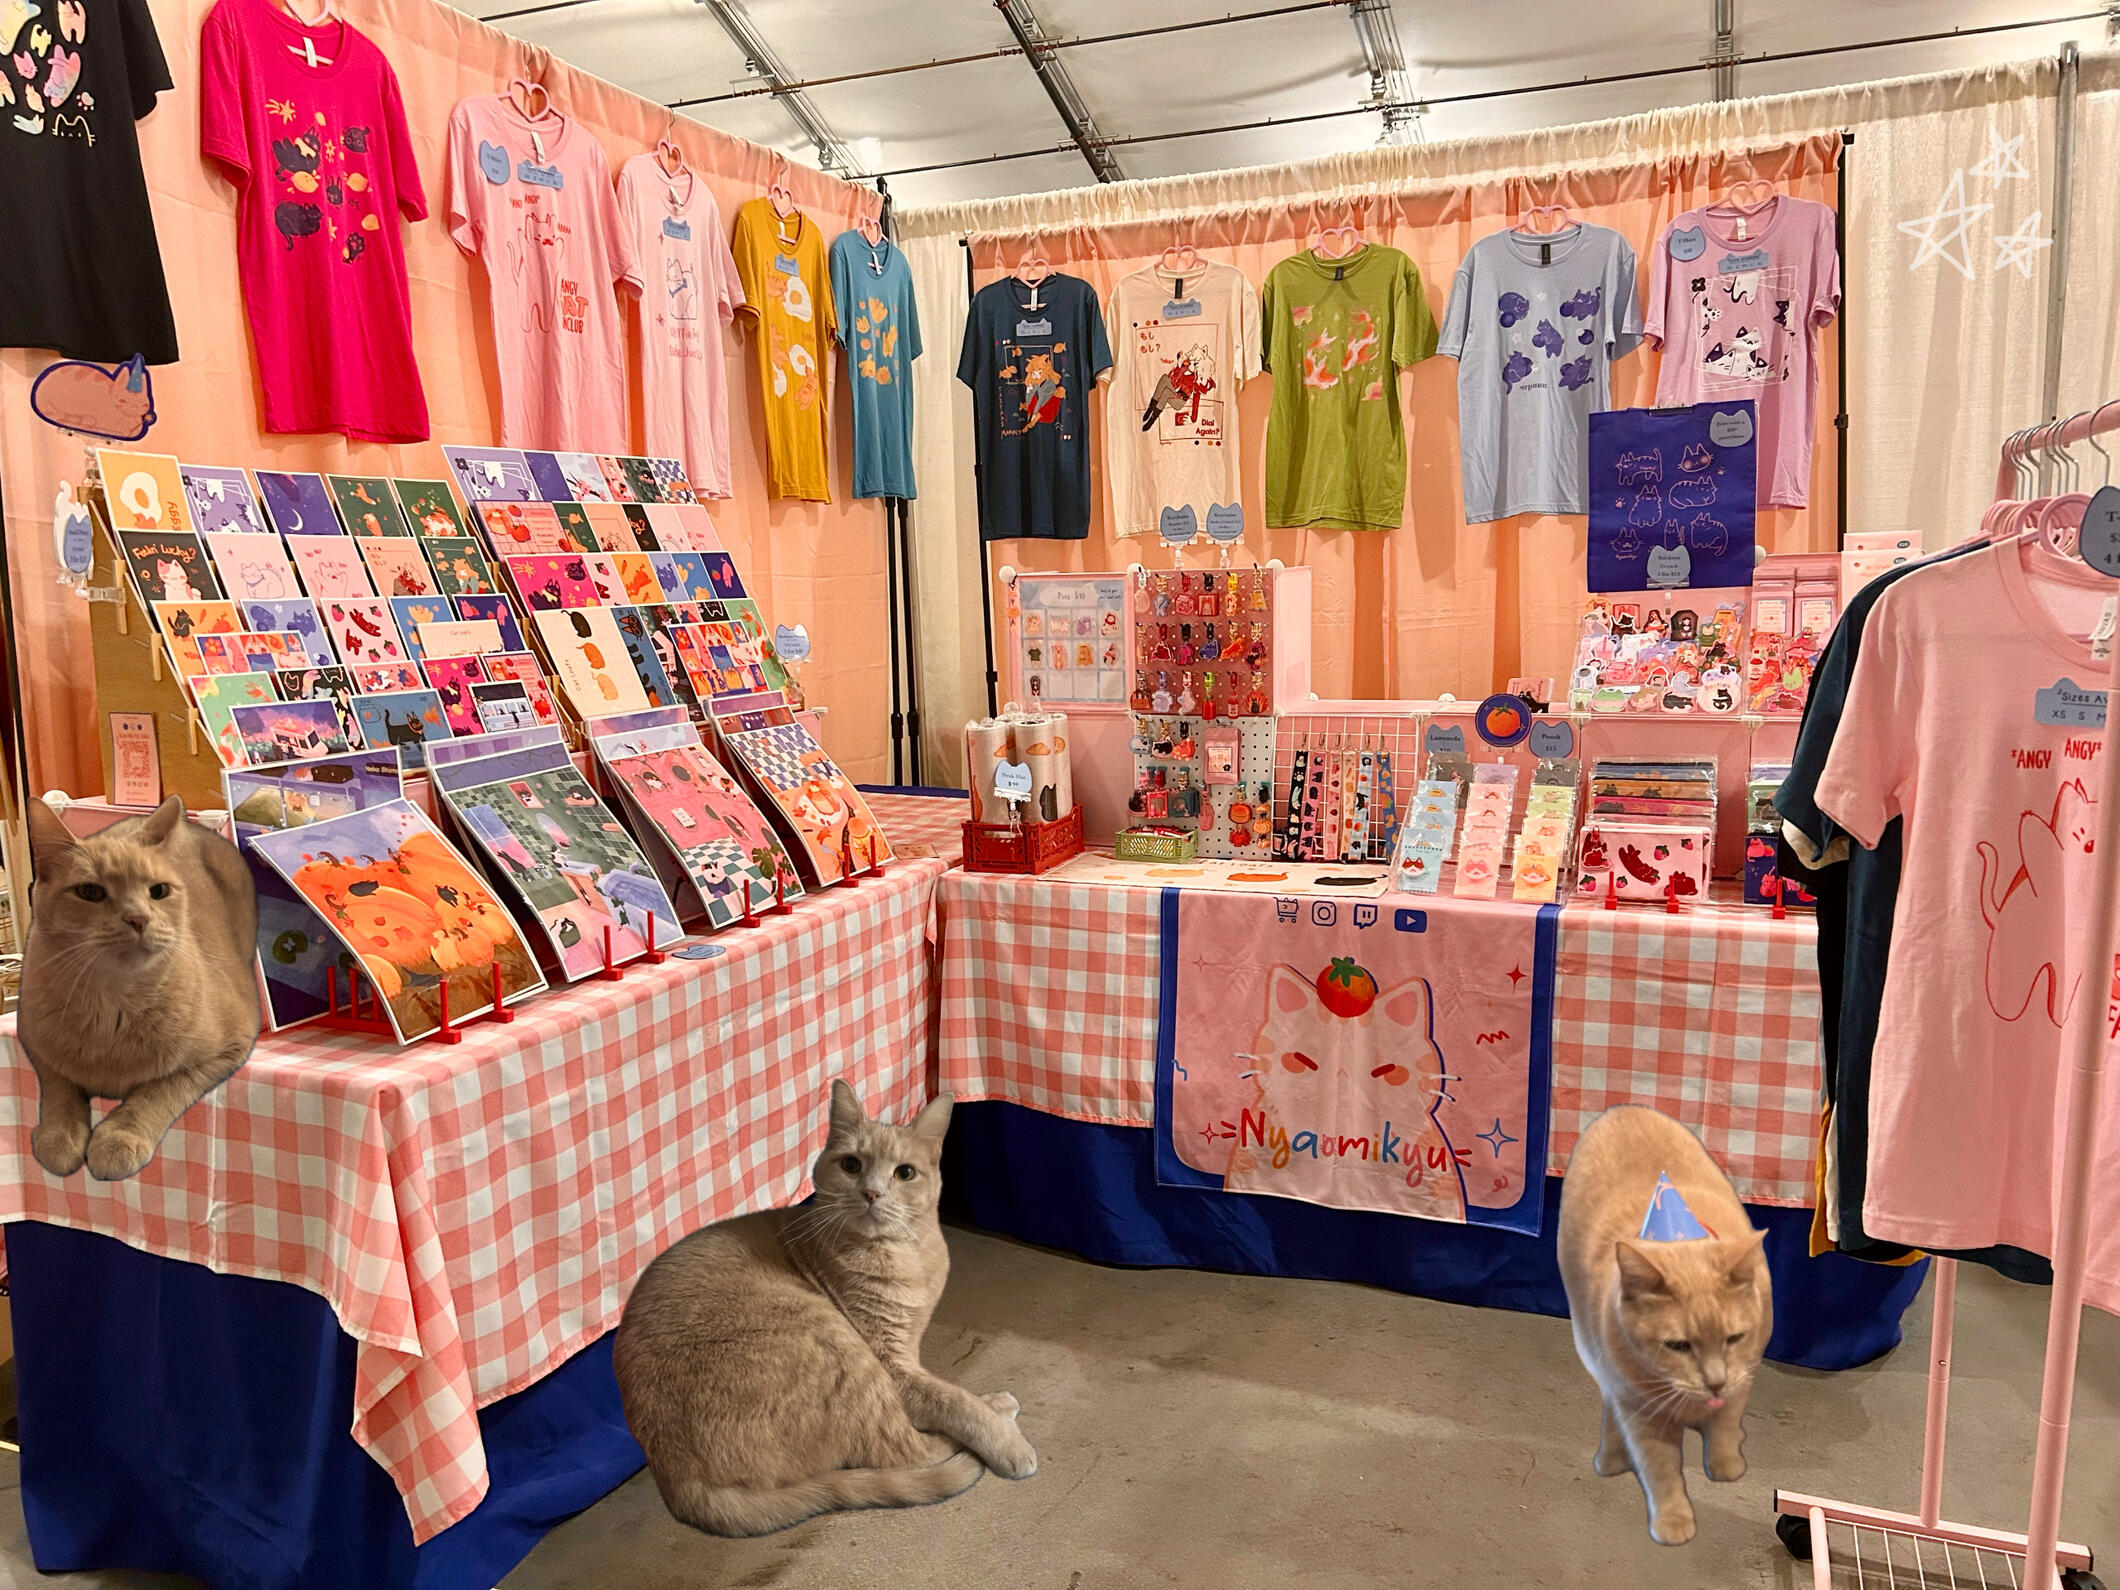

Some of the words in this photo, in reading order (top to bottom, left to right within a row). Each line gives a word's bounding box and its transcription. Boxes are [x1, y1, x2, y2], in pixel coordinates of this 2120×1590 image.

[560, 278, 579, 296] ANGY
[560, 295, 590, 319] AT
[1201, 419, 1215, 427] Dial
[1195, 427, 1221, 436] Again?
[2051, 709, 2067, 719] XS
[2078, 711, 2086, 721] S
[1430, 734, 1461, 743] Lanyards
